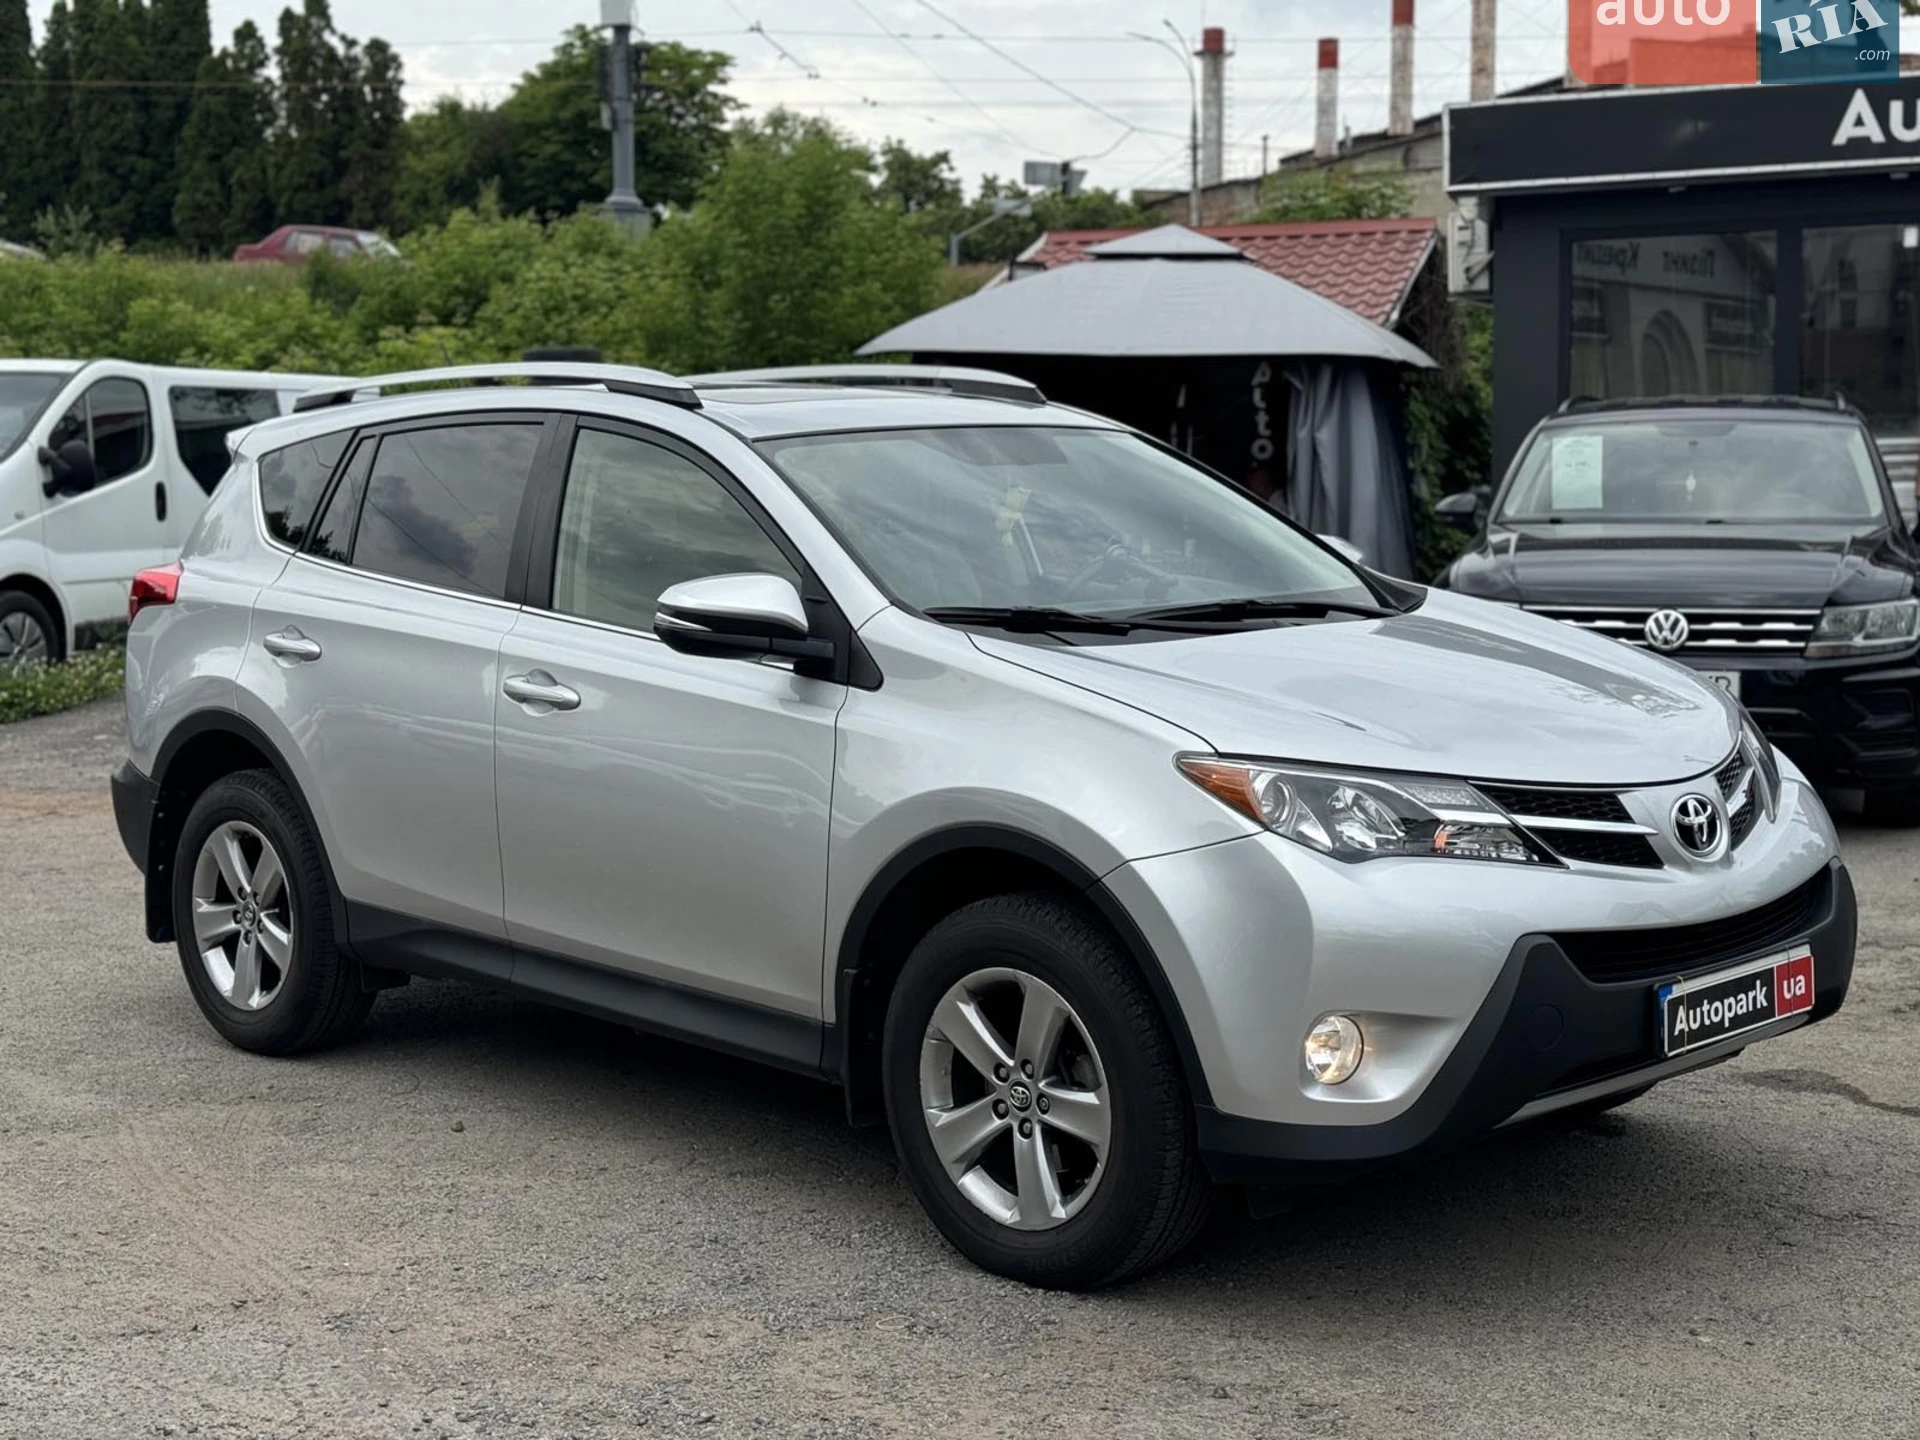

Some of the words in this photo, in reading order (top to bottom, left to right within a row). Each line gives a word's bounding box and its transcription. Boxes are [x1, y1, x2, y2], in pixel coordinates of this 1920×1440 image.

[1831, 88, 1920, 146] Au
[1673, 979, 1769, 1036] Autopark
[1783, 974, 1806, 1000] ua
